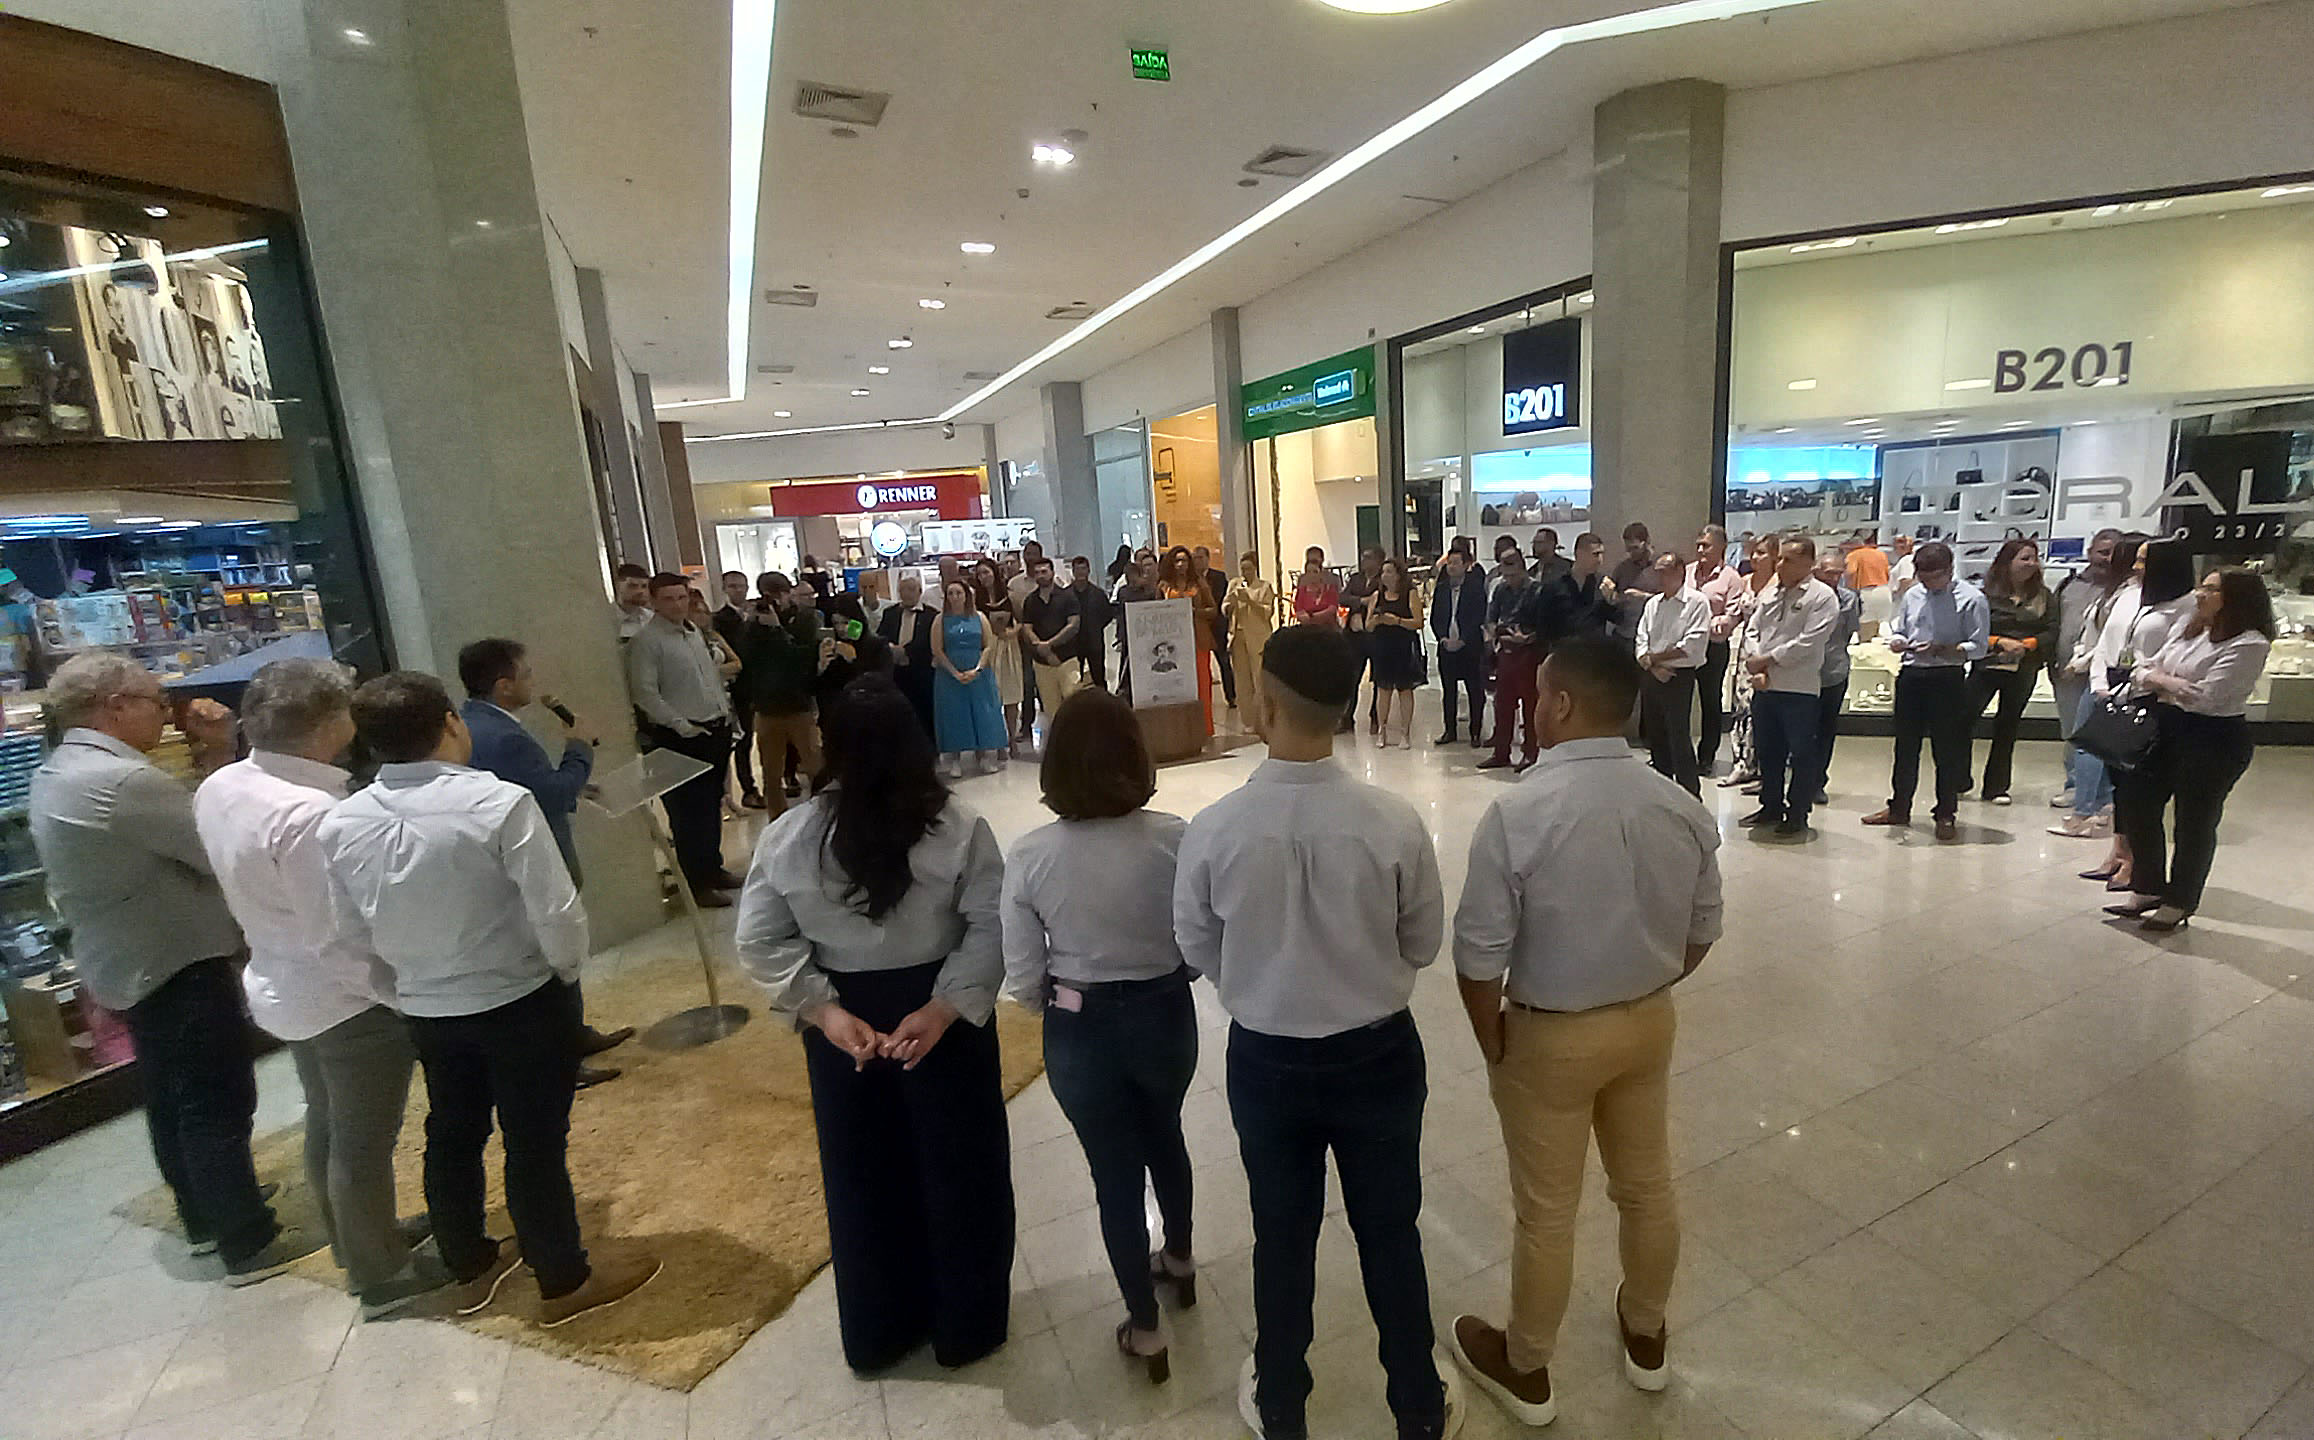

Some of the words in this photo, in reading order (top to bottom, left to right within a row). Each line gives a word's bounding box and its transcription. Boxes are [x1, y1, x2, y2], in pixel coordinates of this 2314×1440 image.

[1994, 341, 2133, 393] B201
[1504, 383, 1564, 425] B201
[877, 485, 937, 503] RENNER
